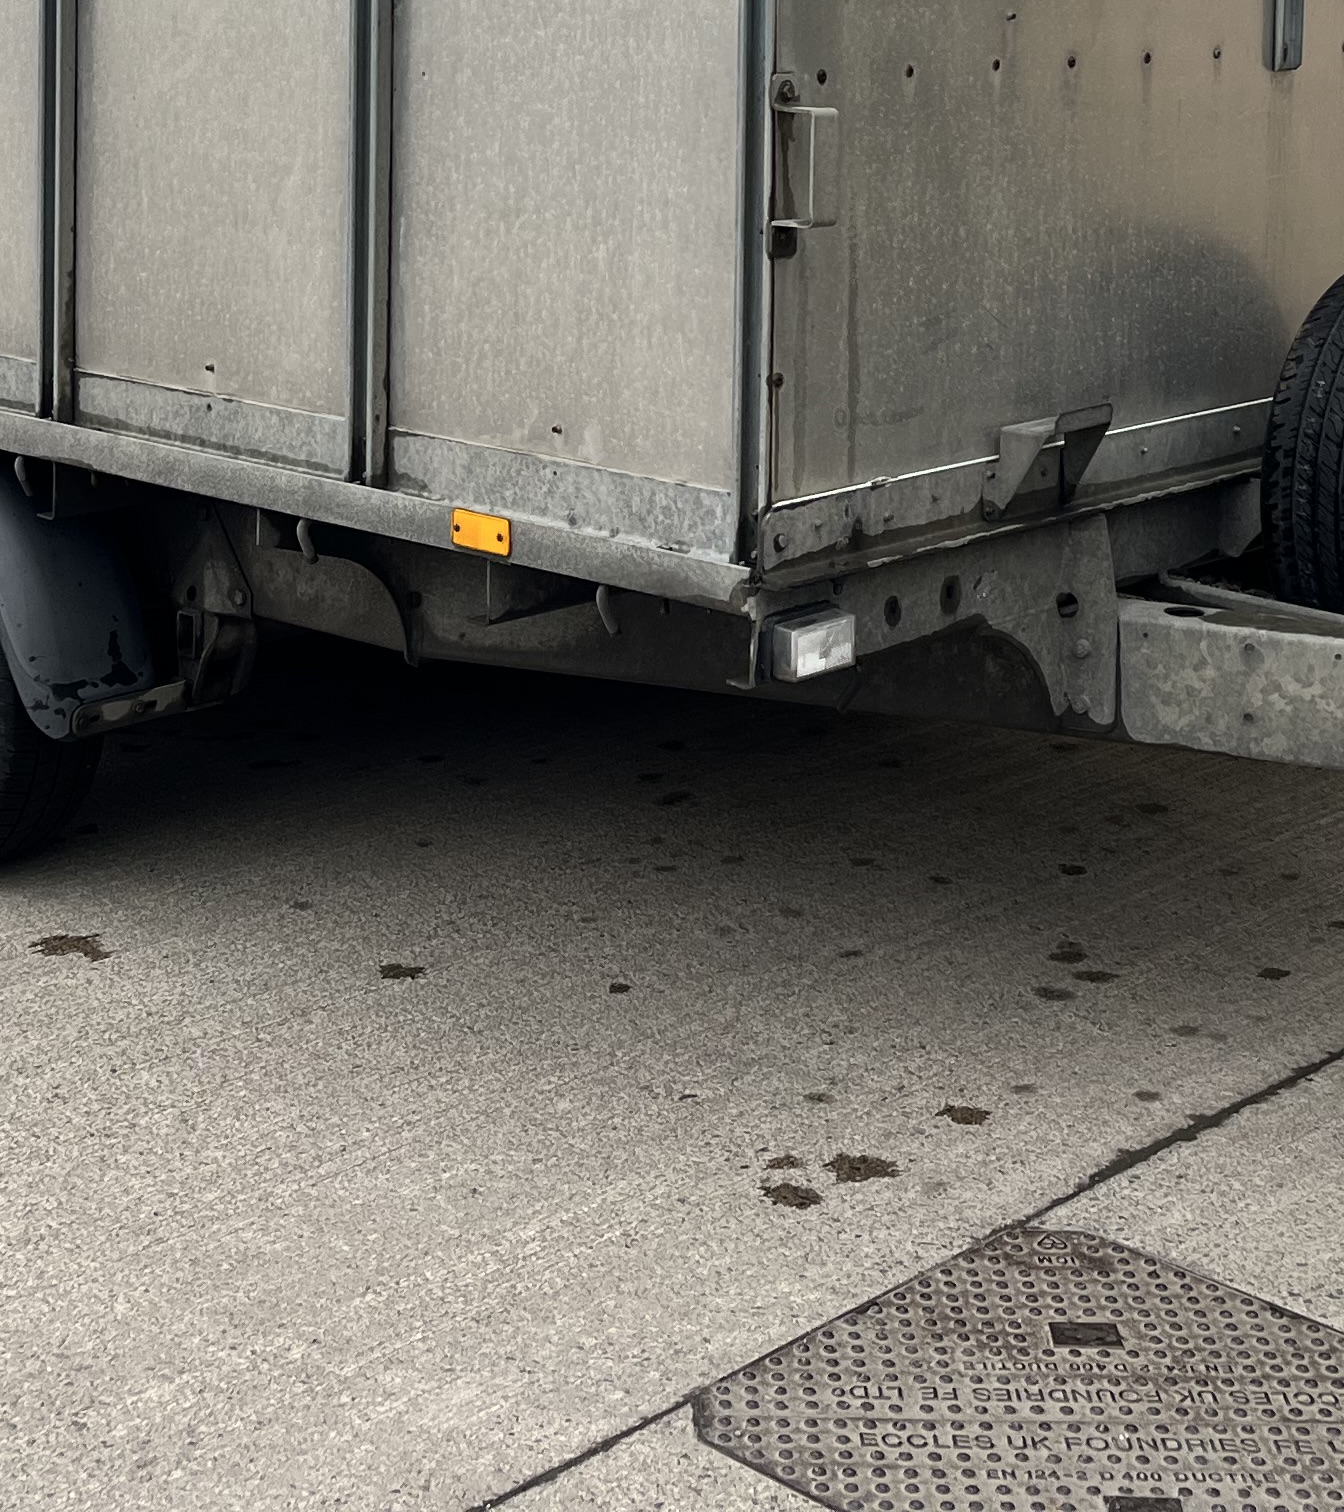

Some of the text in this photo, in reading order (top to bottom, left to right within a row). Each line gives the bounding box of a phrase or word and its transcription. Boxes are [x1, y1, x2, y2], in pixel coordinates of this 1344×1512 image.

[849, 1386, 905, 1402] LTD
[972, 1388, 1164, 1405] FOUNDRIES
[1177, 1389, 1219, 1405] UK
[859, 1432, 996, 1450] ECCLES
[1006, 1435, 1052, 1452] UK
[1064, 1436, 1262, 1454] FOUNDRIES
[1172, 1471, 1280, 1485] DUCTILE
